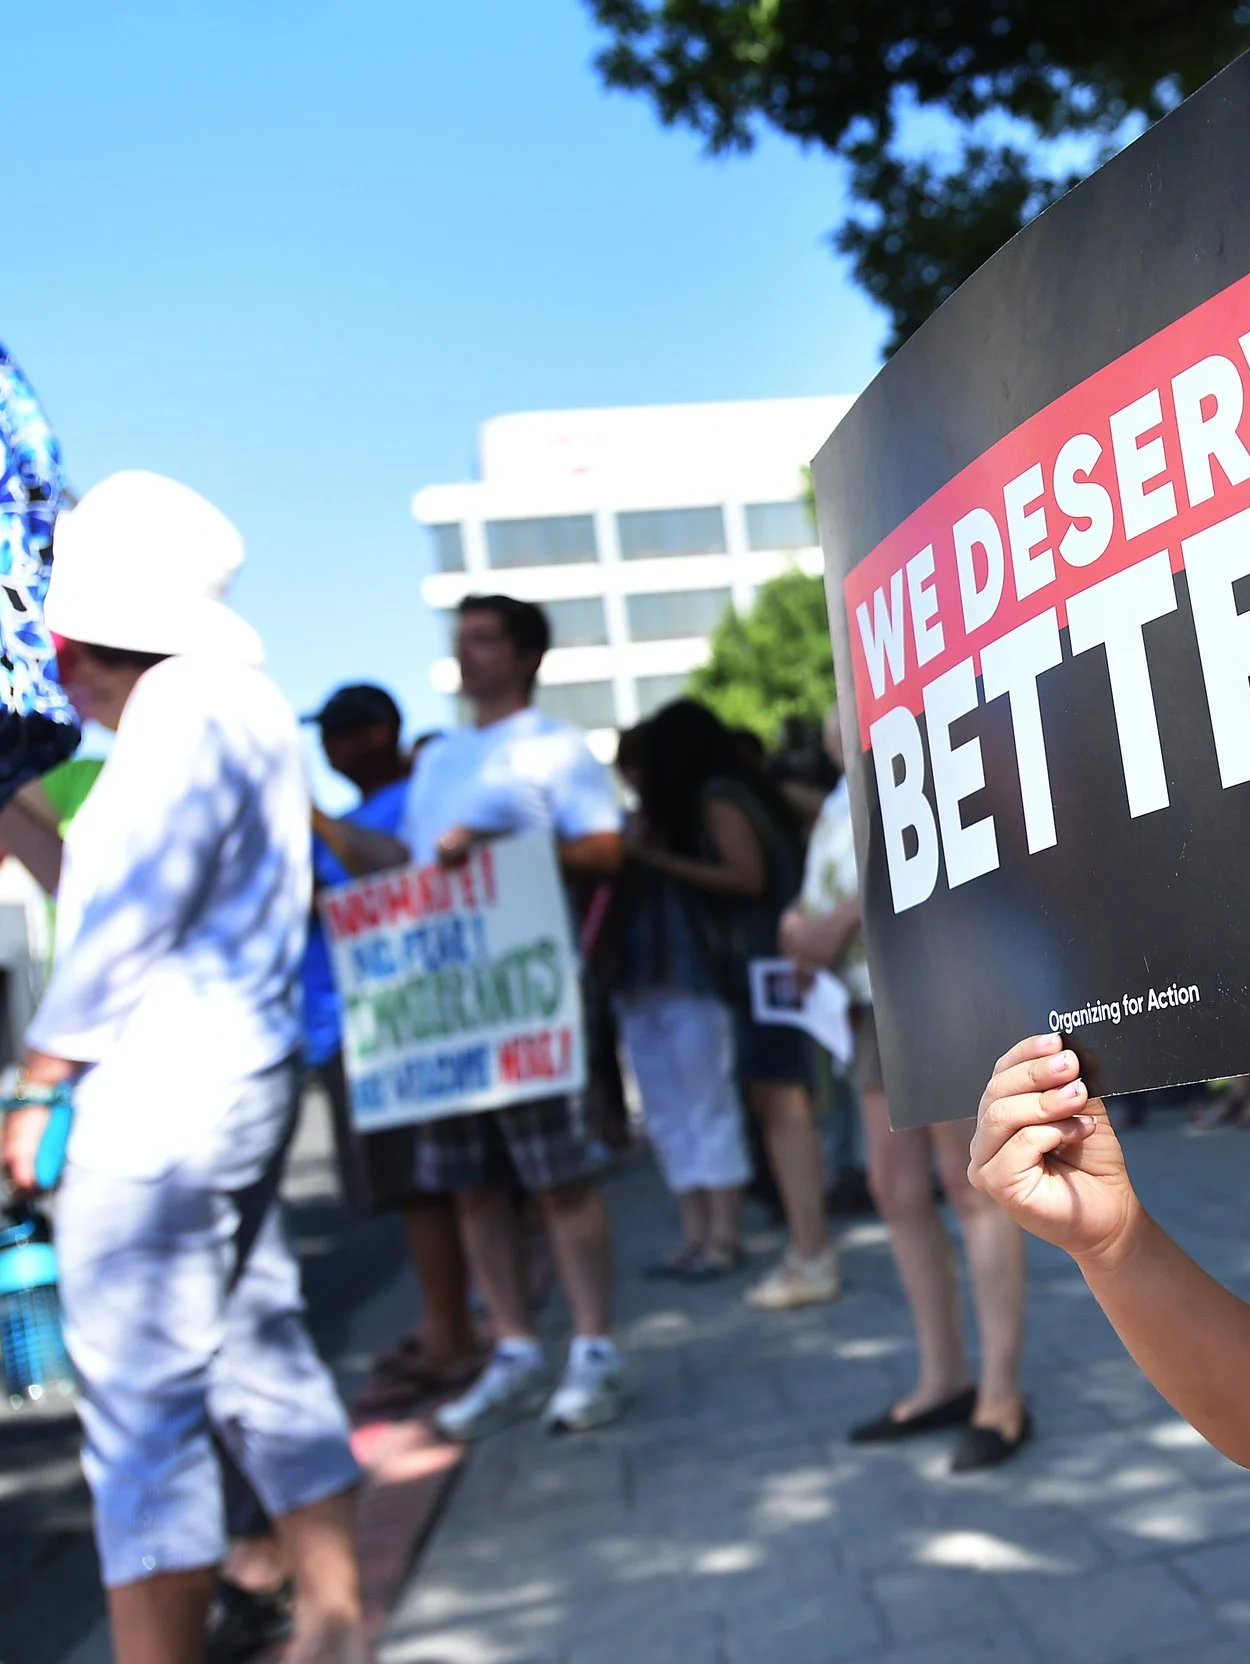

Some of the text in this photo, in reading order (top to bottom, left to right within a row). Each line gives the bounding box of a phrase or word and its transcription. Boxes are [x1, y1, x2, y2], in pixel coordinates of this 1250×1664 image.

[857, 545, 945, 700] WE
[1049, 983, 1200, 1034] Organizing for Action
